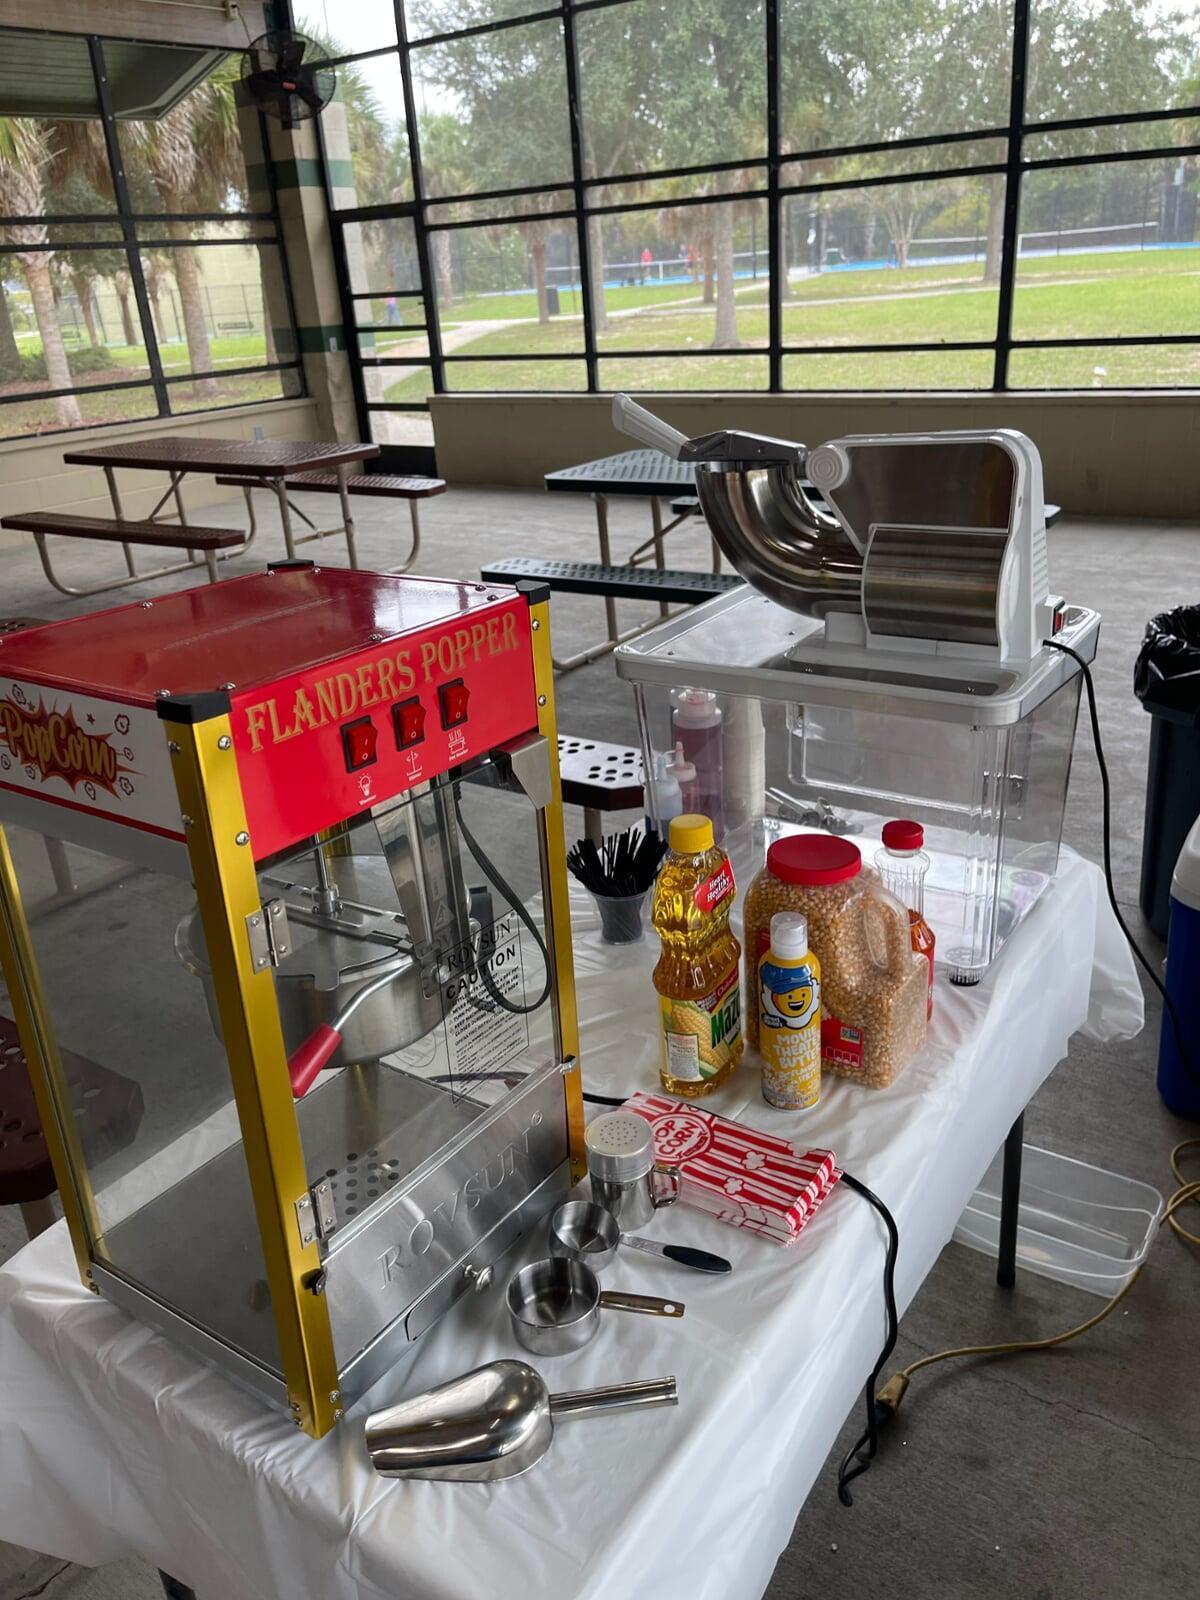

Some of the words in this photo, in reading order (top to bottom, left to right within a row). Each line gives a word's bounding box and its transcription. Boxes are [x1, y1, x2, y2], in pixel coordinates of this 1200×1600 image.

[245, 650, 418, 752] FLANDERS
[421, 612, 519, 682] POPPER
[0, 703, 117, 783] PopCorn
[709, 869, 726, 891] Heart
[446, 944, 516, 999] CAUTION
[772, 1036, 819, 1058] THEATE
[776, 1026, 818, 1046] MOVIE
[659, 1121, 699, 1155] CORN
